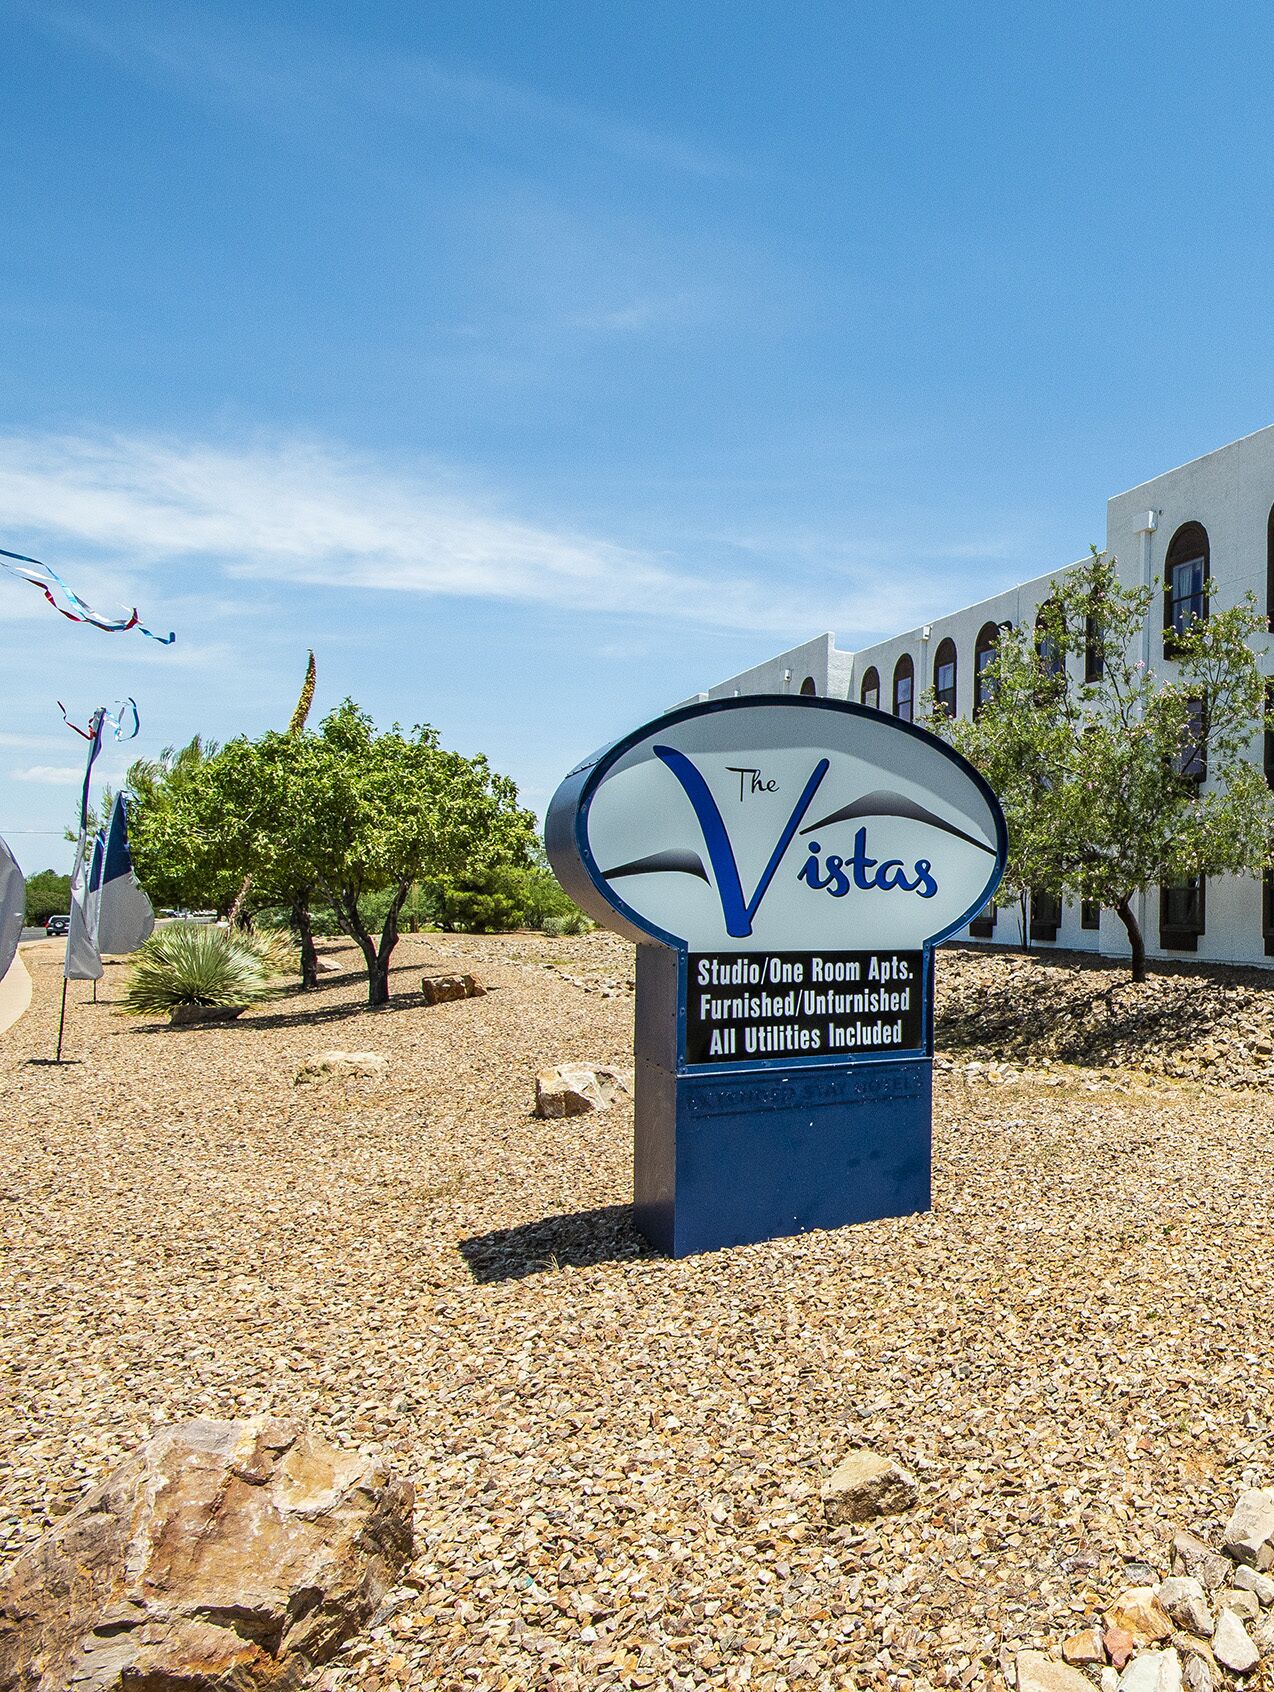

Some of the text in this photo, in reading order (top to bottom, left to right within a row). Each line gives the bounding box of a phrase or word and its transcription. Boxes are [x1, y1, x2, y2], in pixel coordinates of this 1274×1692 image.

[725, 766, 780, 802] The
[652, 744, 938, 938] Vistas
[697, 956, 914, 986] Studio/One Room Apts.
[700, 987, 910, 1021] Furnished/Unfurnished
[709, 1019, 902, 1056] All Utilities Included
